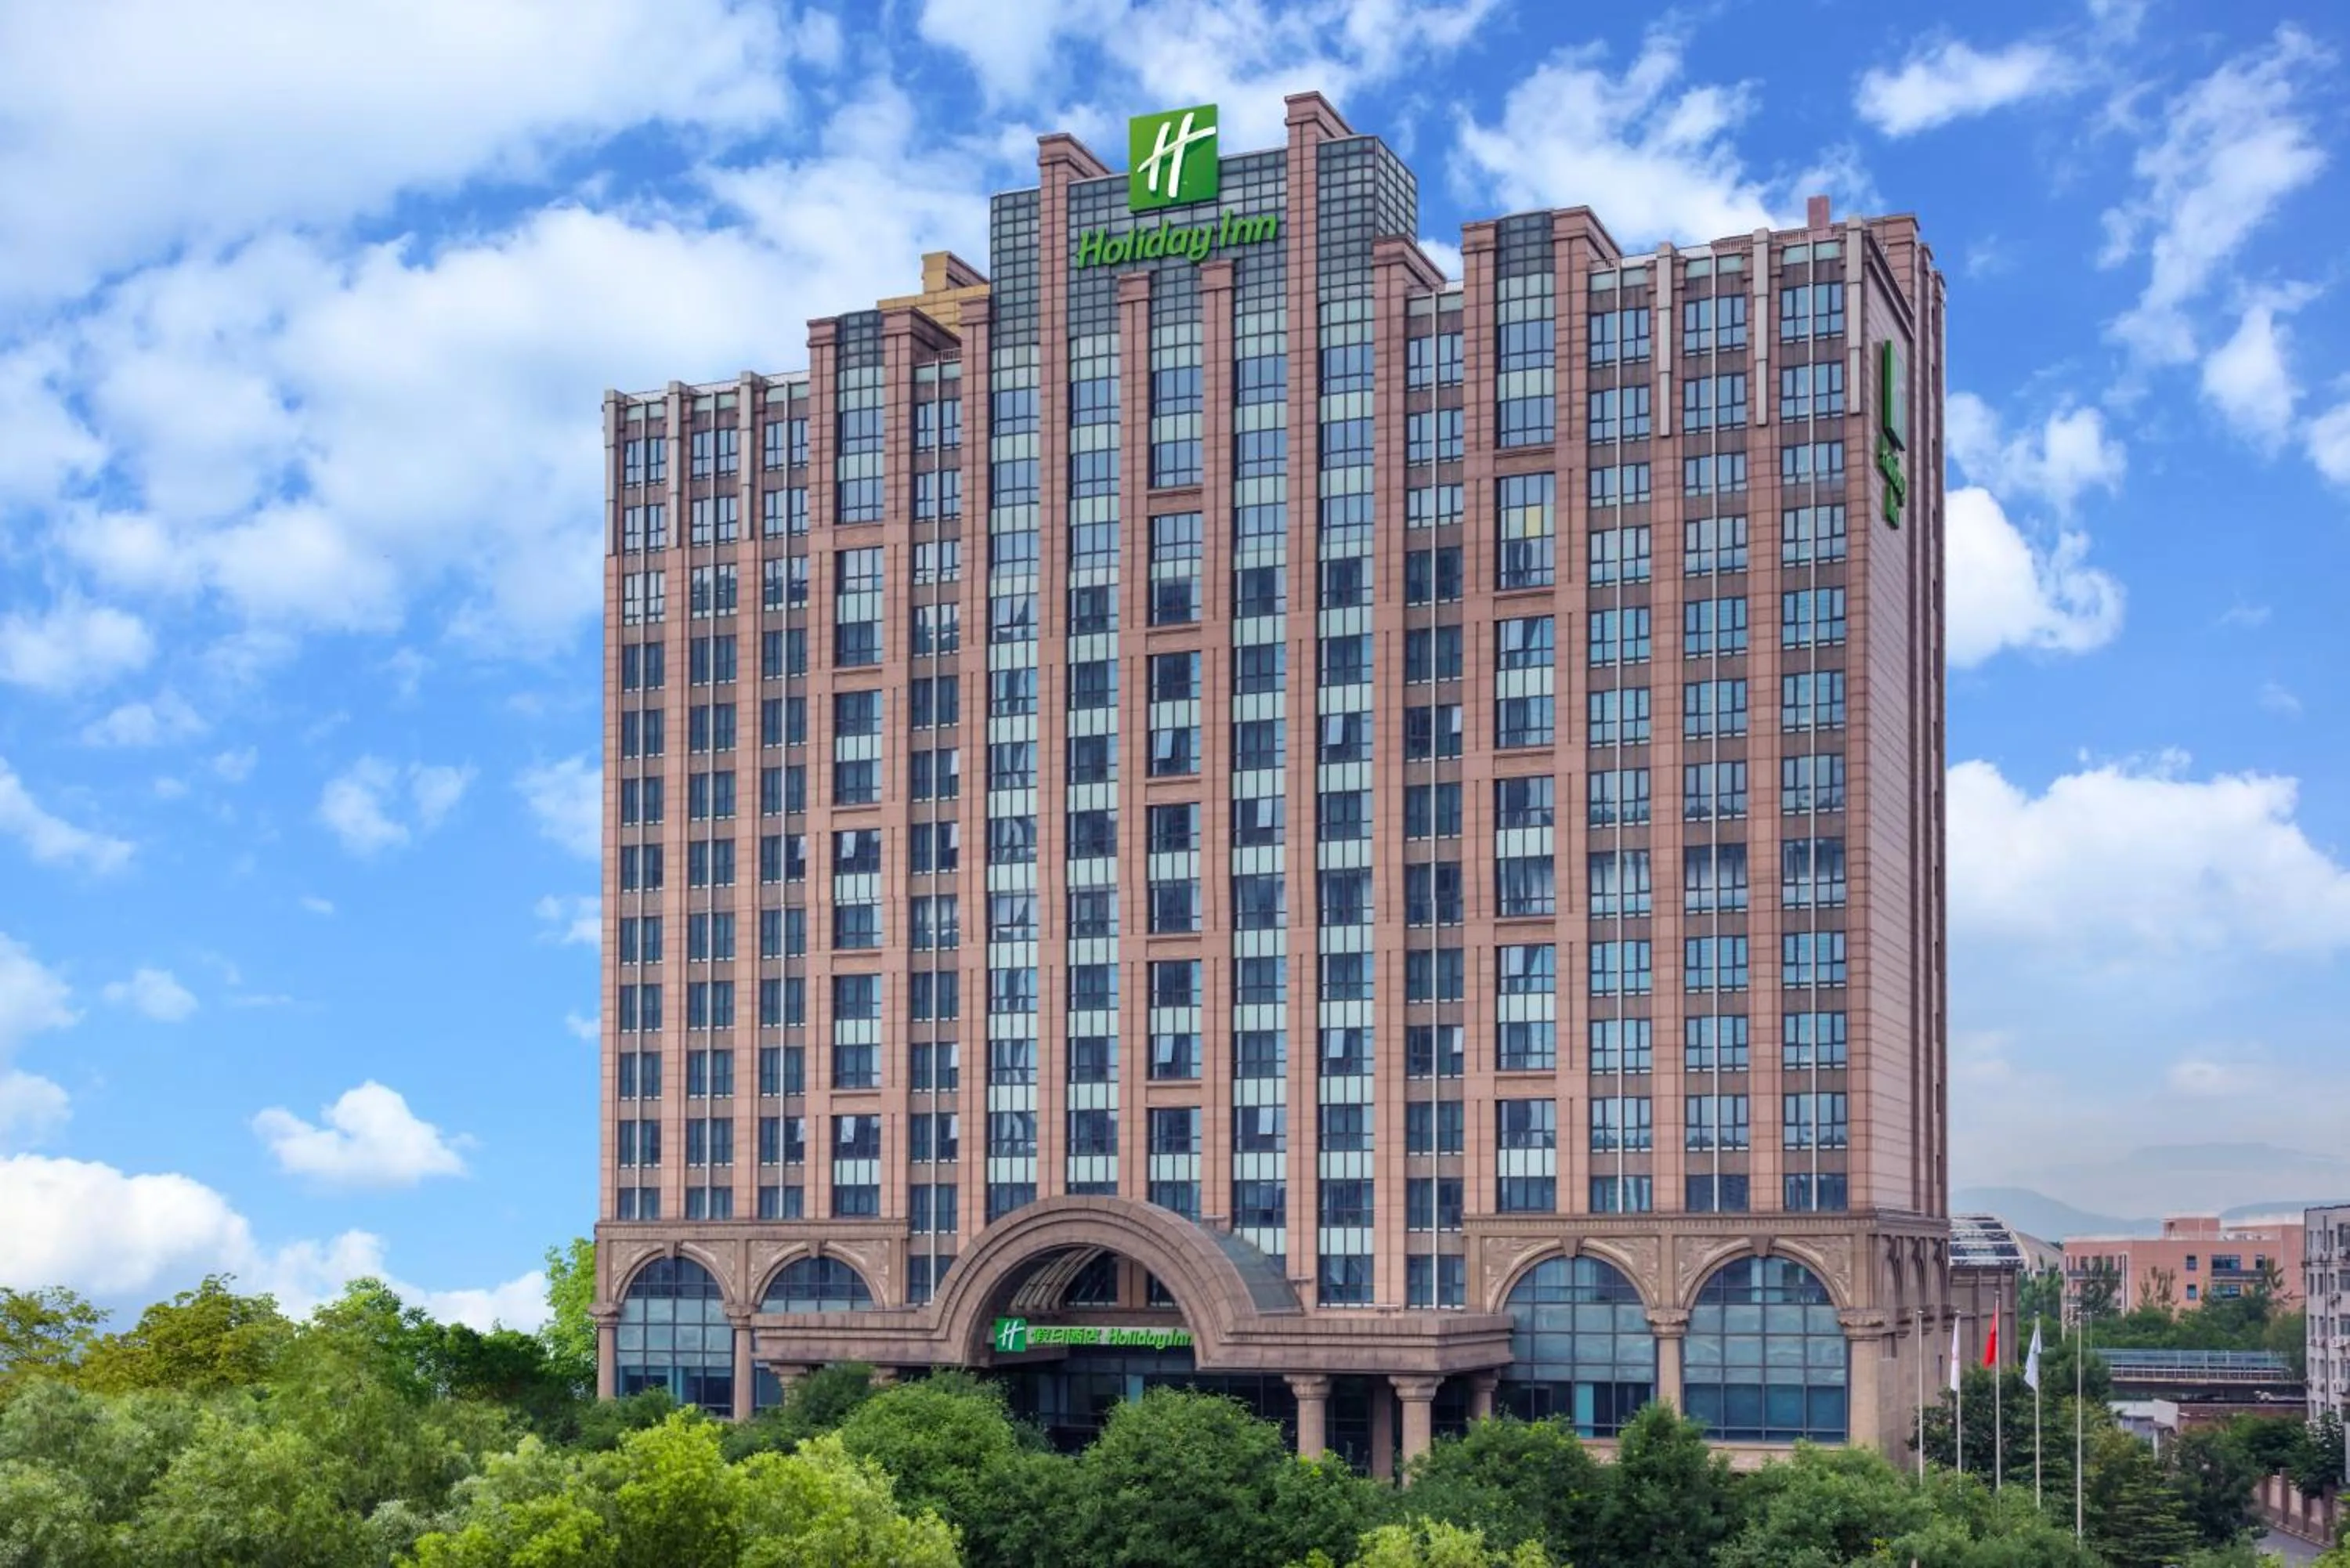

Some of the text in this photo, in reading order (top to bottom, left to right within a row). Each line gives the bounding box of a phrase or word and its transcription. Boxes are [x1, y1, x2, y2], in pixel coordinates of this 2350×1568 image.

[1137, 112, 1216, 197] H
[1077, 208, 1278, 269] Holiday Inn
[997, 1321, 1025, 1350] H
[1106, 1328, 1169, 1349] Holiday
